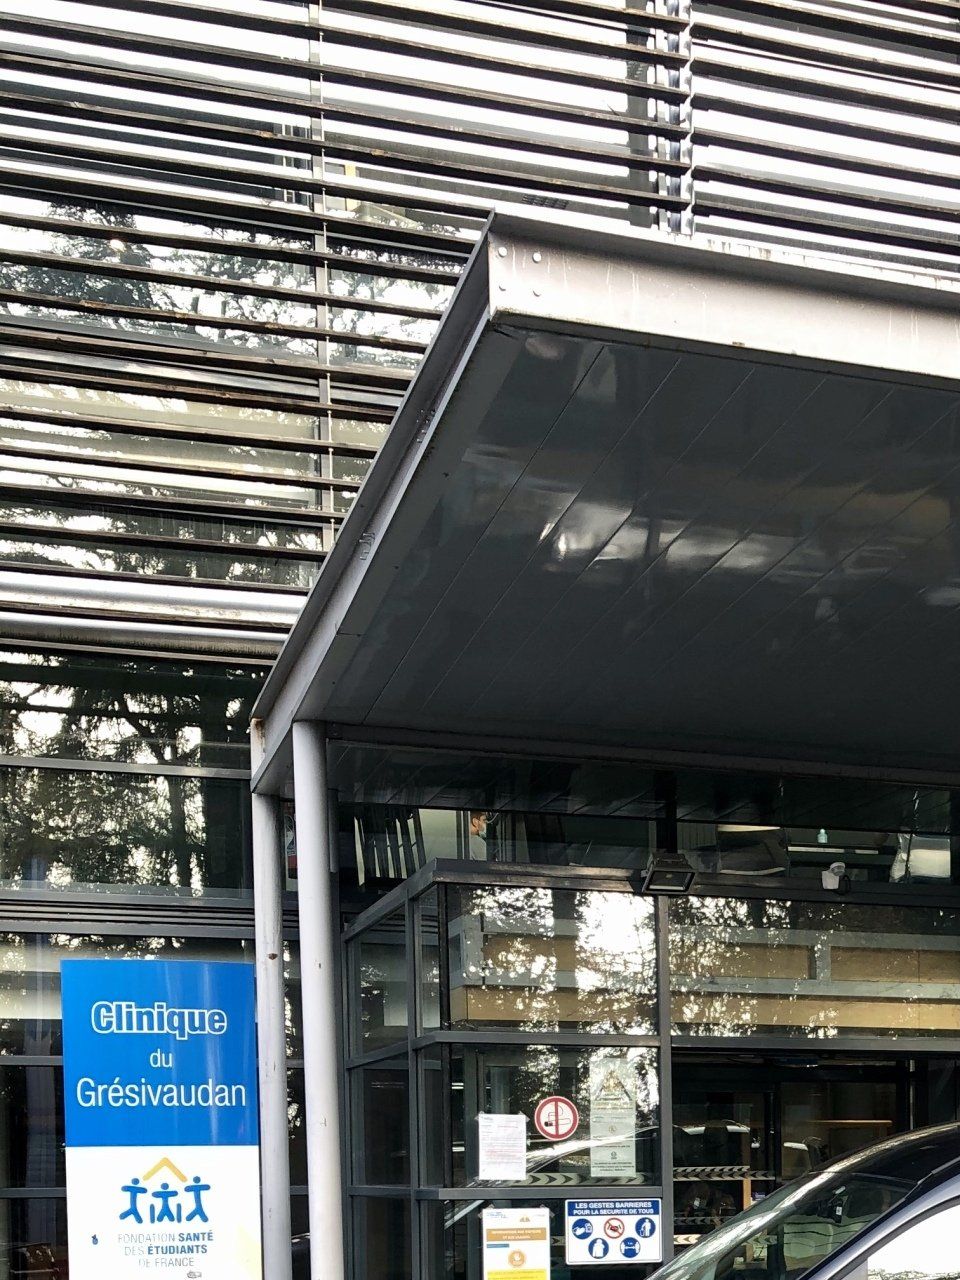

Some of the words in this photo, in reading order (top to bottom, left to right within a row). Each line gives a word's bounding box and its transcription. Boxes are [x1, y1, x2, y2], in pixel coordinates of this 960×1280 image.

[91, 1001, 228, 1040] Clinique
[150, 1049, 173, 1068] du
[76, 1076, 246, 1107] Grésivaudan
[118, 1233, 176, 1244] FONDATION
[178, 1230, 213, 1242] SANTÉ
[124, 1246, 145, 1256] DES
[147, 1244, 208, 1255] ÉTUDIANTS
[138, 1258, 151, 1268] DE
[154, 1257, 195, 1268] FRANCE
